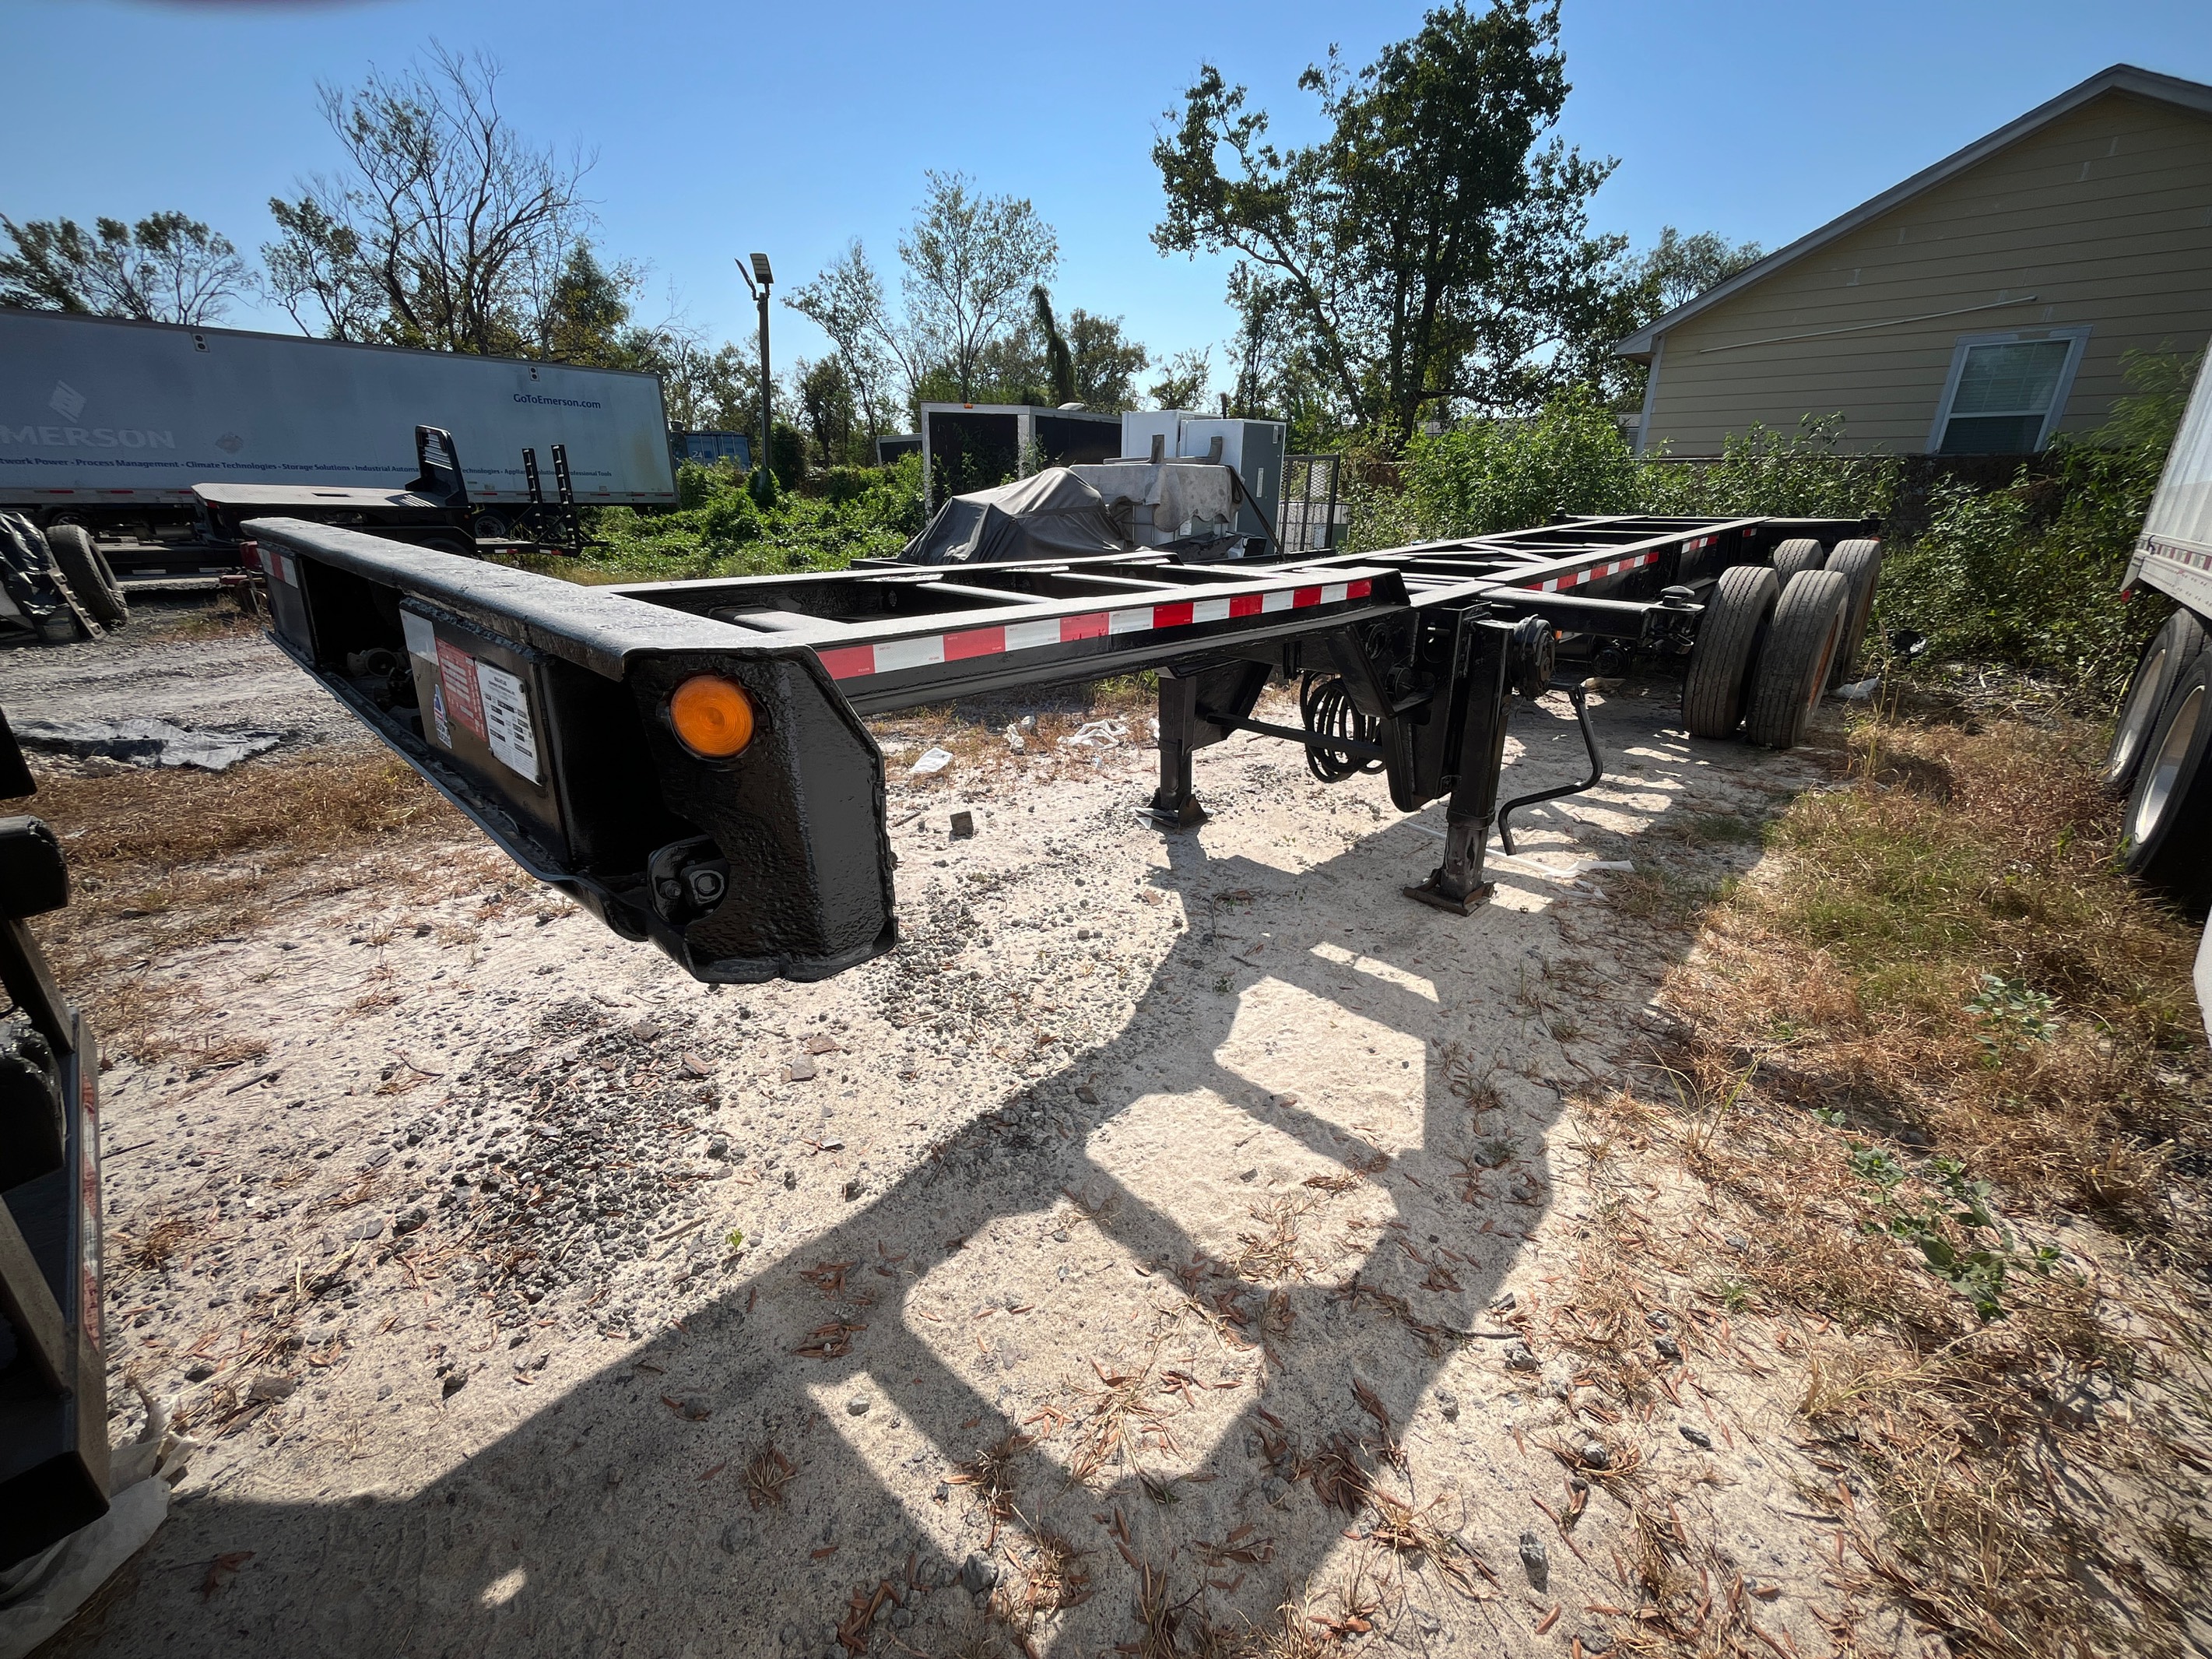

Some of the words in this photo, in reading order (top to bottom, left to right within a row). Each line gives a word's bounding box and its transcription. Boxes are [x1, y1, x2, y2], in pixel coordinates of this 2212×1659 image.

[513, 393, 601, 409] GoToEmerson.com
[35, 457, 69, 466] Power
[75, 458, 114, 467] Process
[116, 459, 180, 469] Management
[222, 462, 277, 471] Technologies
[282, 463, 313, 472] Storage
[314, 463, 350, 472] Solutions
[355, 464, 390, 473] Industrial
[462, 467, 500, 476] echnologies
